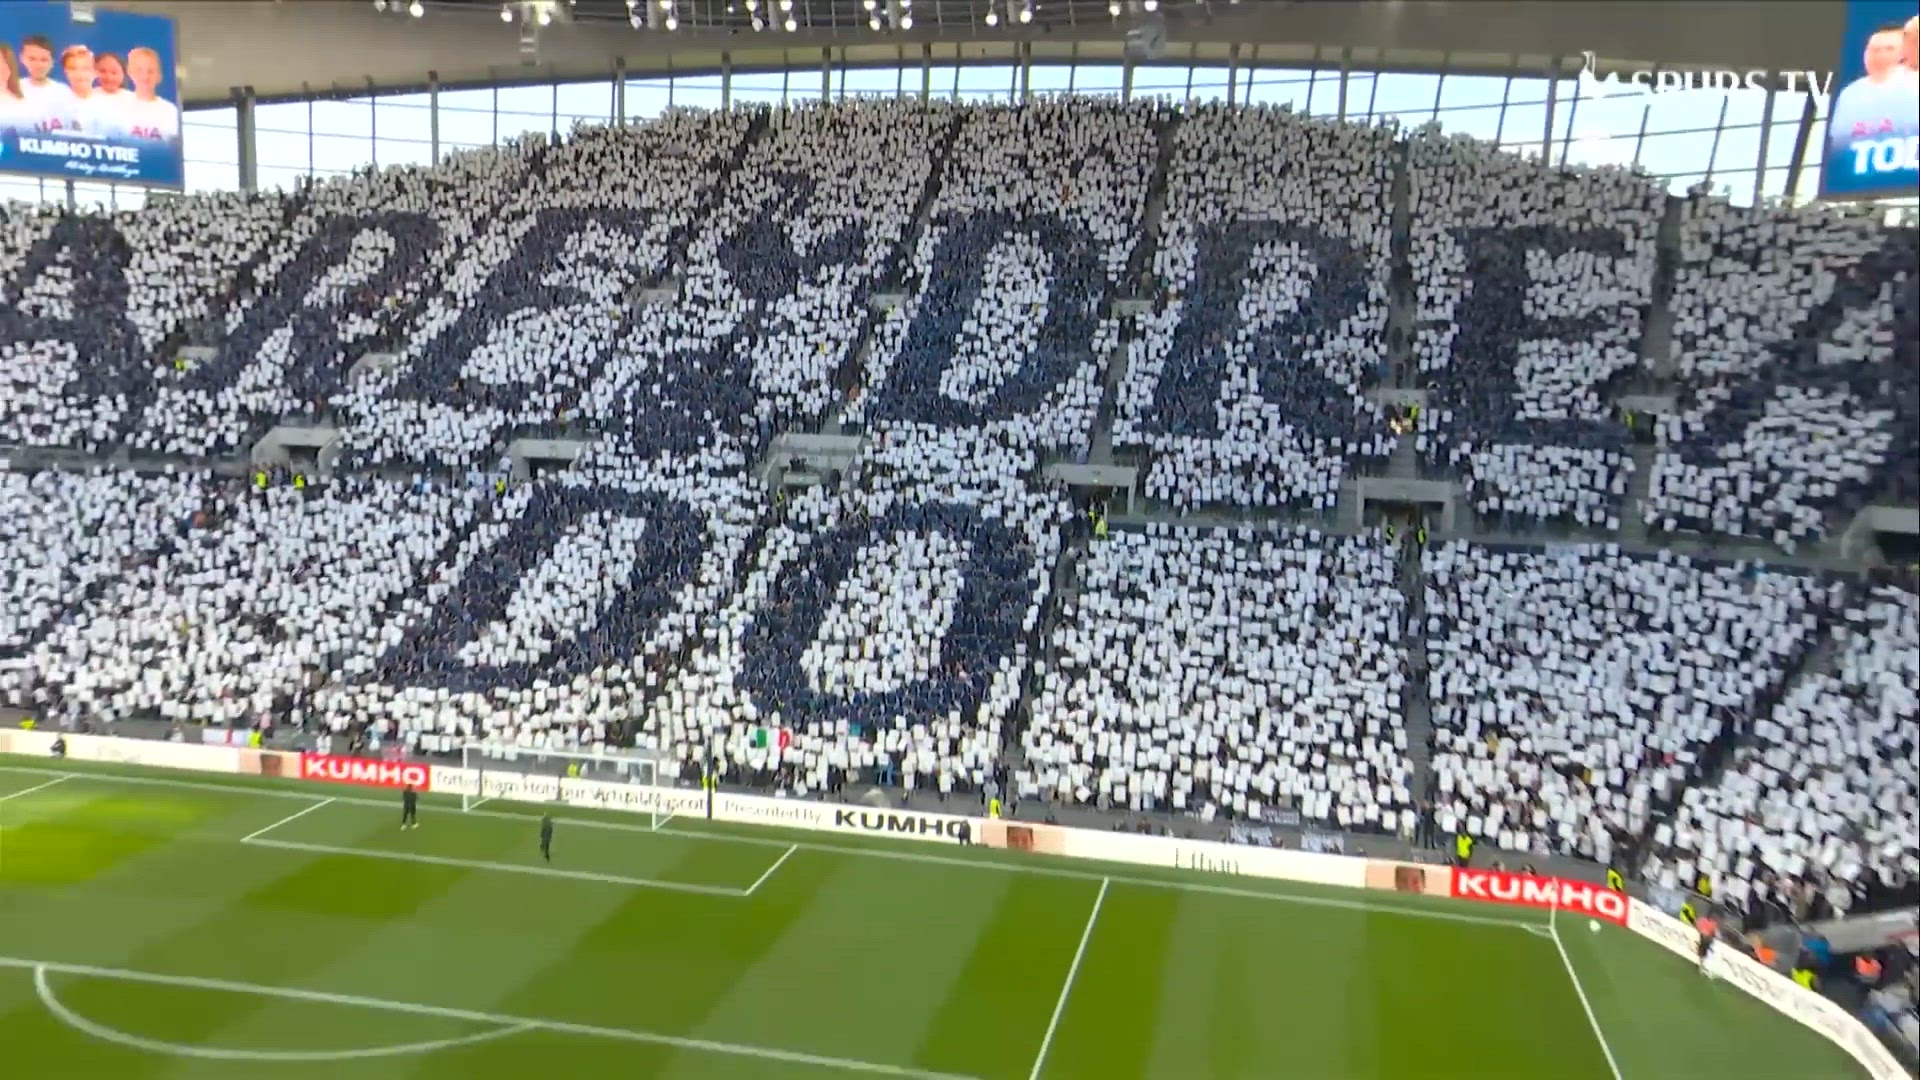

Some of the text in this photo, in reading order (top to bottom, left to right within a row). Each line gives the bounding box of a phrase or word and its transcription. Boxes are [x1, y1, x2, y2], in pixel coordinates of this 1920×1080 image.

[19, 136, 140, 163] KUMHO TYRE
[384, 484, 1038, 722] DO
[306, 754, 427, 788] KUMHO
[435, 771, 518, 794] Tottenham
[725, 799, 799, 821] Presented
[804, 812, 822, 827] By
[1459, 872, 1626, 919] KUMHO
